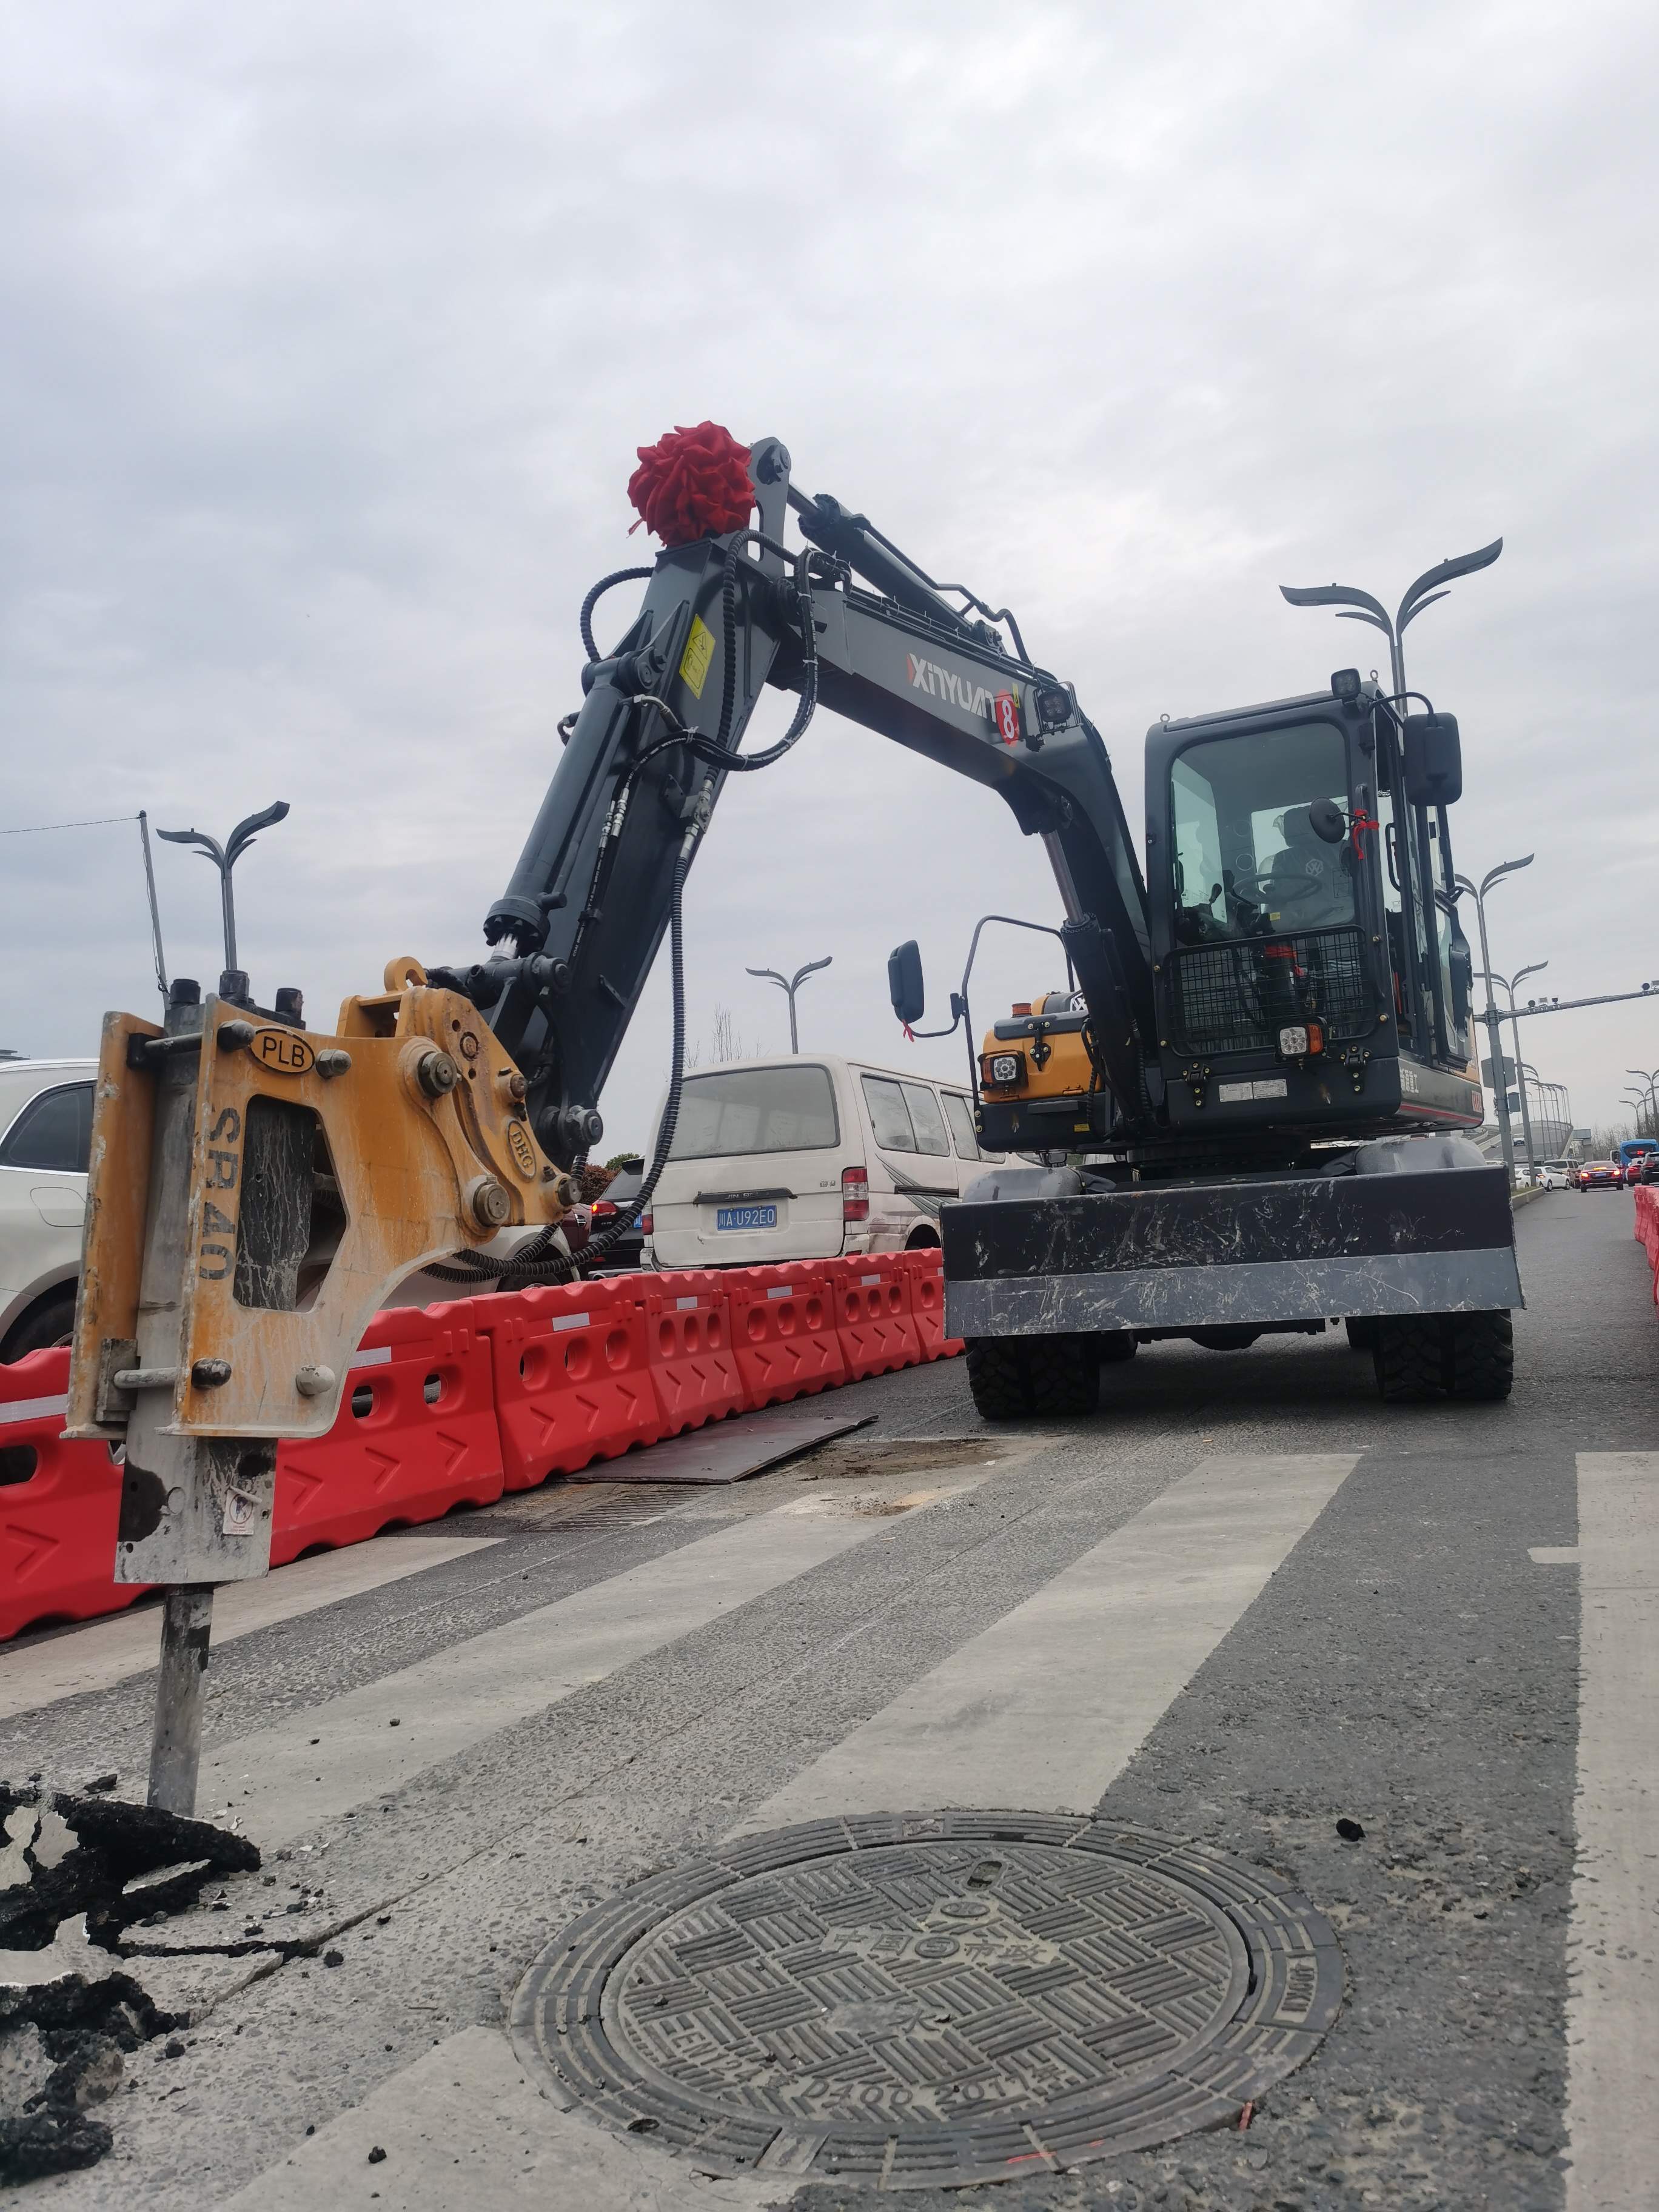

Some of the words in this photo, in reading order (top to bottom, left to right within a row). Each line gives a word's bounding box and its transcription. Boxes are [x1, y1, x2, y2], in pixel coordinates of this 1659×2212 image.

[1002, 699, 1014, 739] 8
[262, 1036, 304, 1068] PLB
[834, 1930, 914, 1956] 中国
[964, 1939, 1048, 1965] 市政
